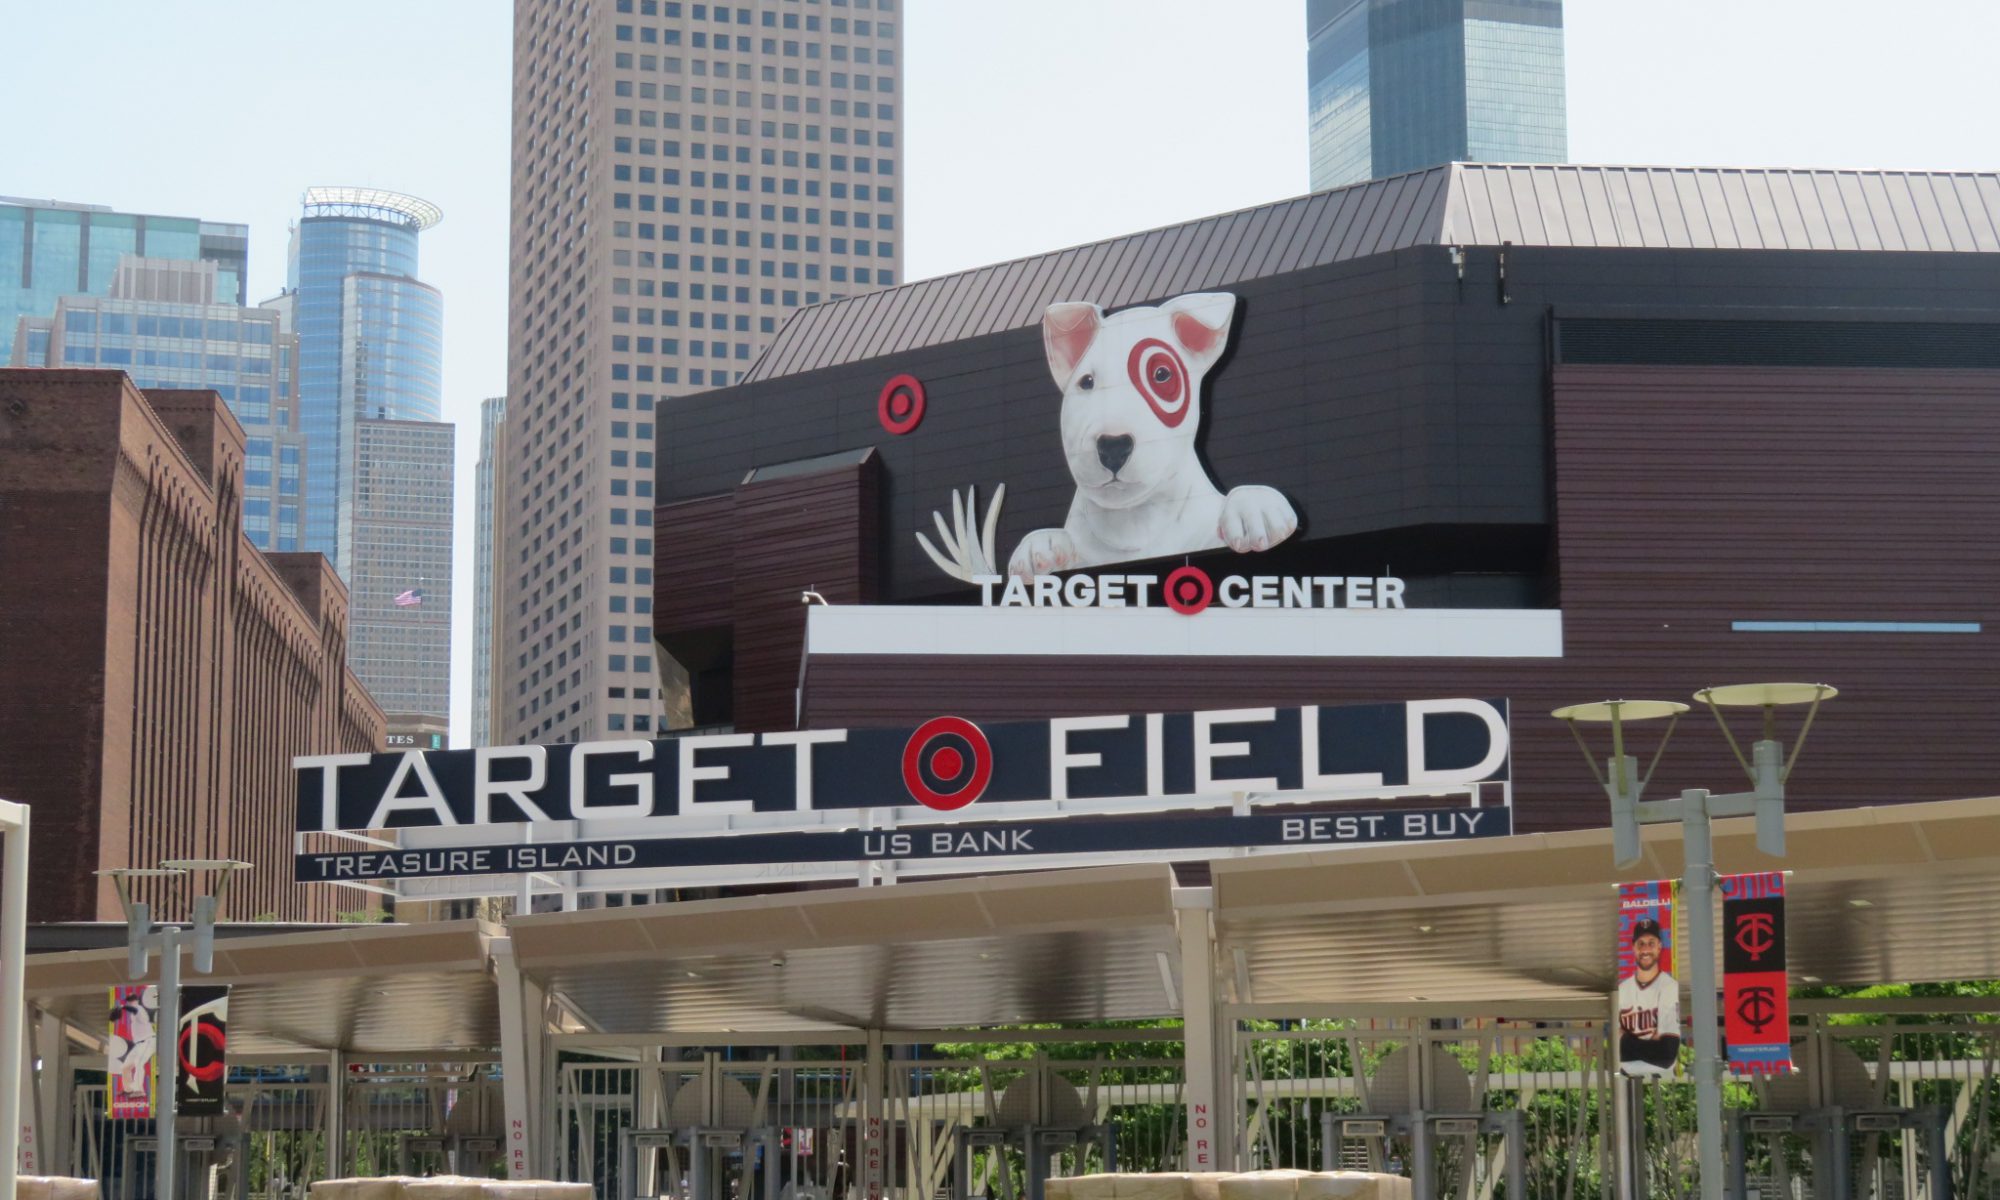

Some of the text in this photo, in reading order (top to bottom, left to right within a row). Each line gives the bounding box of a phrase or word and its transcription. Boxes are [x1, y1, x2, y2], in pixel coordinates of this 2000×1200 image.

[976, 574, 1407, 609] TARGET CENTER
[292, 698, 1509, 831] TARGET FIELD
[1281, 811, 1484, 842] BEST BUY
[862, 828, 1034, 856] US BANK
[314, 850, 492, 879] TREASURE
[505, 843, 637, 870] ISLAND
[1623, 898, 1671, 909] BALDELLI
[512, 1119, 522, 1140] NO
[869, 1117, 879, 1138] NO
[1195, 1104, 1207, 1129] NO
[23, 1125, 33, 1144] NO
